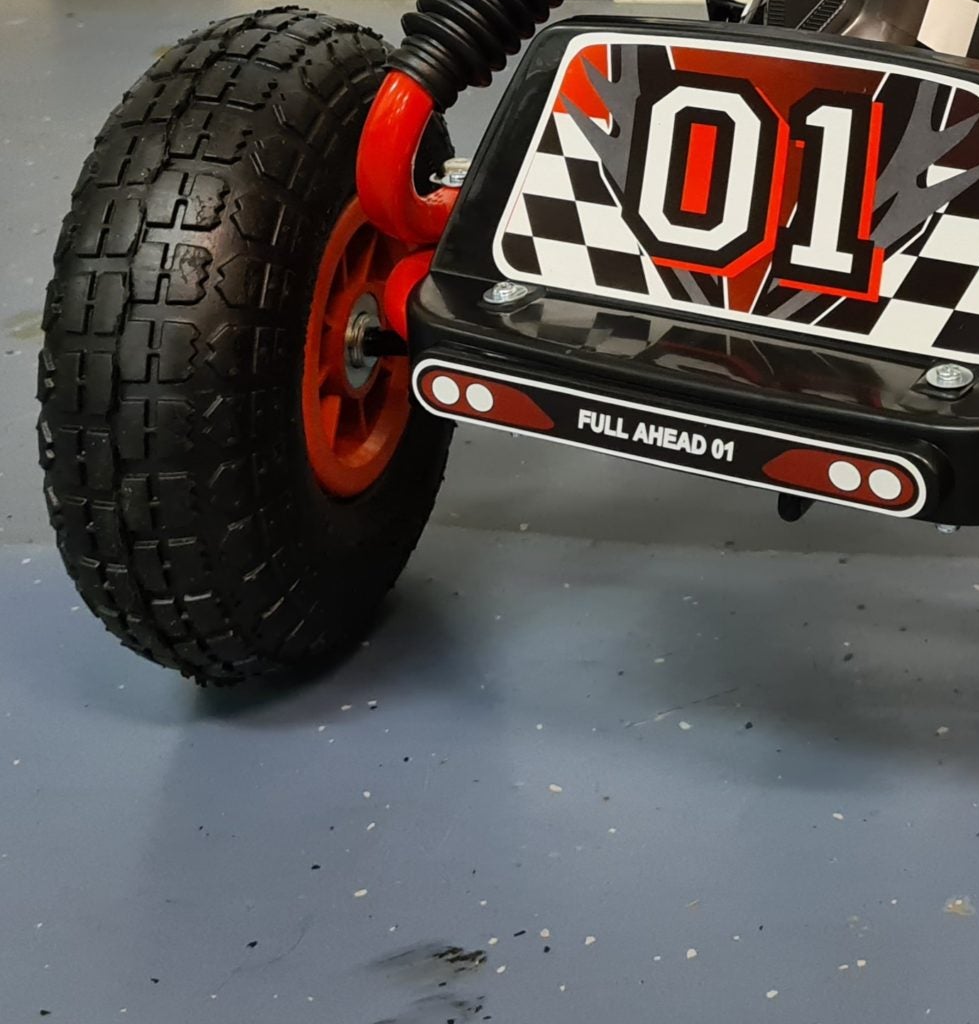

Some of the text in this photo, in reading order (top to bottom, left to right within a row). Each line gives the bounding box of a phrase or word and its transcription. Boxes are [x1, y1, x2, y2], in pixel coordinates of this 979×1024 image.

[634, 82, 858, 275] 01
[577, 408, 735, 462] FULL AHEAD 01
